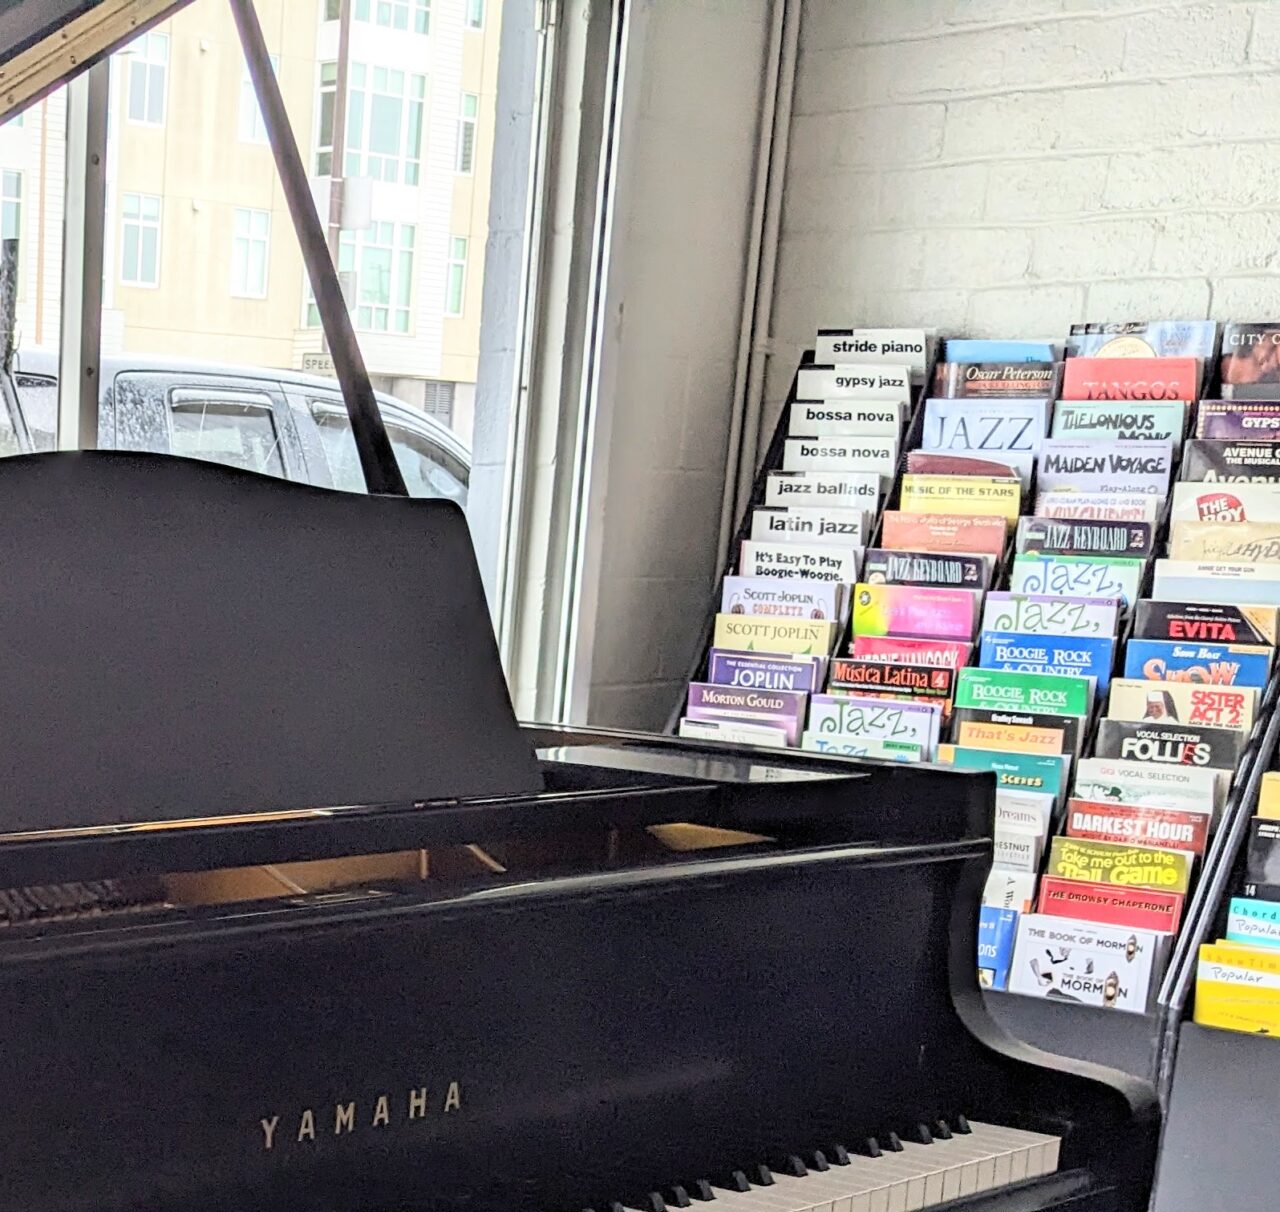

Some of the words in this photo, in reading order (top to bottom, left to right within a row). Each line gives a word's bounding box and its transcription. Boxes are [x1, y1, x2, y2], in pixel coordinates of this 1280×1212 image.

[833, 340, 877, 353] stride
[882, 340, 923, 355] piano
[1229, 333, 1266, 346] CITY
[966, 366, 1001, 380] Oscar
[1002, 366, 1053, 380] Peterson
[835, 376, 876, 389] gypsy
[878, 376, 904, 388] jazz
[1081, 381, 1181, 401] TANGOS
[806, 408, 852, 421] bossa
[857, 412, 894, 422] nova
[1061, 409, 1155, 431] THELONIOUS
[931, 417, 1034, 451] JAZZ
[801, 445, 847, 457] bossa
[852, 448, 890, 459] nova
[1223, 448, 1272, 458] AVENUE
[1044, 454, 1106, 474] MAIDEN
[1109, 454, 1167, 474] VOYAGE
[778, 481, 811, 495] jazz
[817, 482, 875, 496] ballads
[904, 485, 935, 495] MUSIC
[938, 486, 951, 495] OF
[956, 487, 975, 496] THE
[978, 487, 1015, 497] STARS
[1200, 497, 1228, 516] THE
[769, 516, 813, 532] latin
[818, 518, 858, 535] jazz
[1044, 525, 1071, 549] JAZZ
[1073, 526, 1128, 551] KEYBOARD
[755, 551, 773, 563] It's
[776, 553, 801, 566] Easy
[803, 555, 816, 565] To
[820, 557, 842, 569] Play
[886, 556, 911, 581] JAZZ
[913, 558, 962, 584] KEYBOARD
[726, 622, 771, 637] SCOTT
[771, 625, 820, 640] JOPLIN
[1168, 620, 1236, 640] EVITA
[737, 661, 766, 669] ESSENTIAL
[767, 663, 803, 672] COLLECTION
[833, 662, 880, 684] Música
[883, 663, 928, 687] Latina
[730, 669, 794, 690] JOPLIN
[1190, 689, 1246, 709] SISTER
[1189, 706, 1224, 723] ACT
[967, 727, 1016, 742] That's
[1019, 731, 1056, 744] Jazz
[1136, 730, 1160, 740] VOCAL
[1161, 732, 1200, 743] SELECTION
[1122, 737, 1211, 765] FOLLIES
[1118, 769, 1144, 779] VOCAL
[1147, 772, 1190, 783] SELECTION
[1072, 812, 1145, 836] DARKEST
[1147, 818, 1194, 842] HOUR
[1060, 848, 1089, 868] Take
[1090, 856, 1113, 868] me
[1115, 852, 1137, 866] out
[1138, 852, 1152, 863] to
[1154, 851, 1175, 865] the
[1109, 866, 1178, 885] Game
[1245, 884, 1257, 896] 14
[1048, 890, 1065, 899] THE
[1068, 893, 1109, 905] DROWSY
[1111, 898, 1174, 913] CHAPERONE
[1028, 928, 1046, 938] THE
[1049, 931, 1077, 943] BOOK
[1079, 936, 1094, 945] OF
[1210, 966, 1264, 983] Popular
[260, 1081, 461, 1149] YAMAHA
